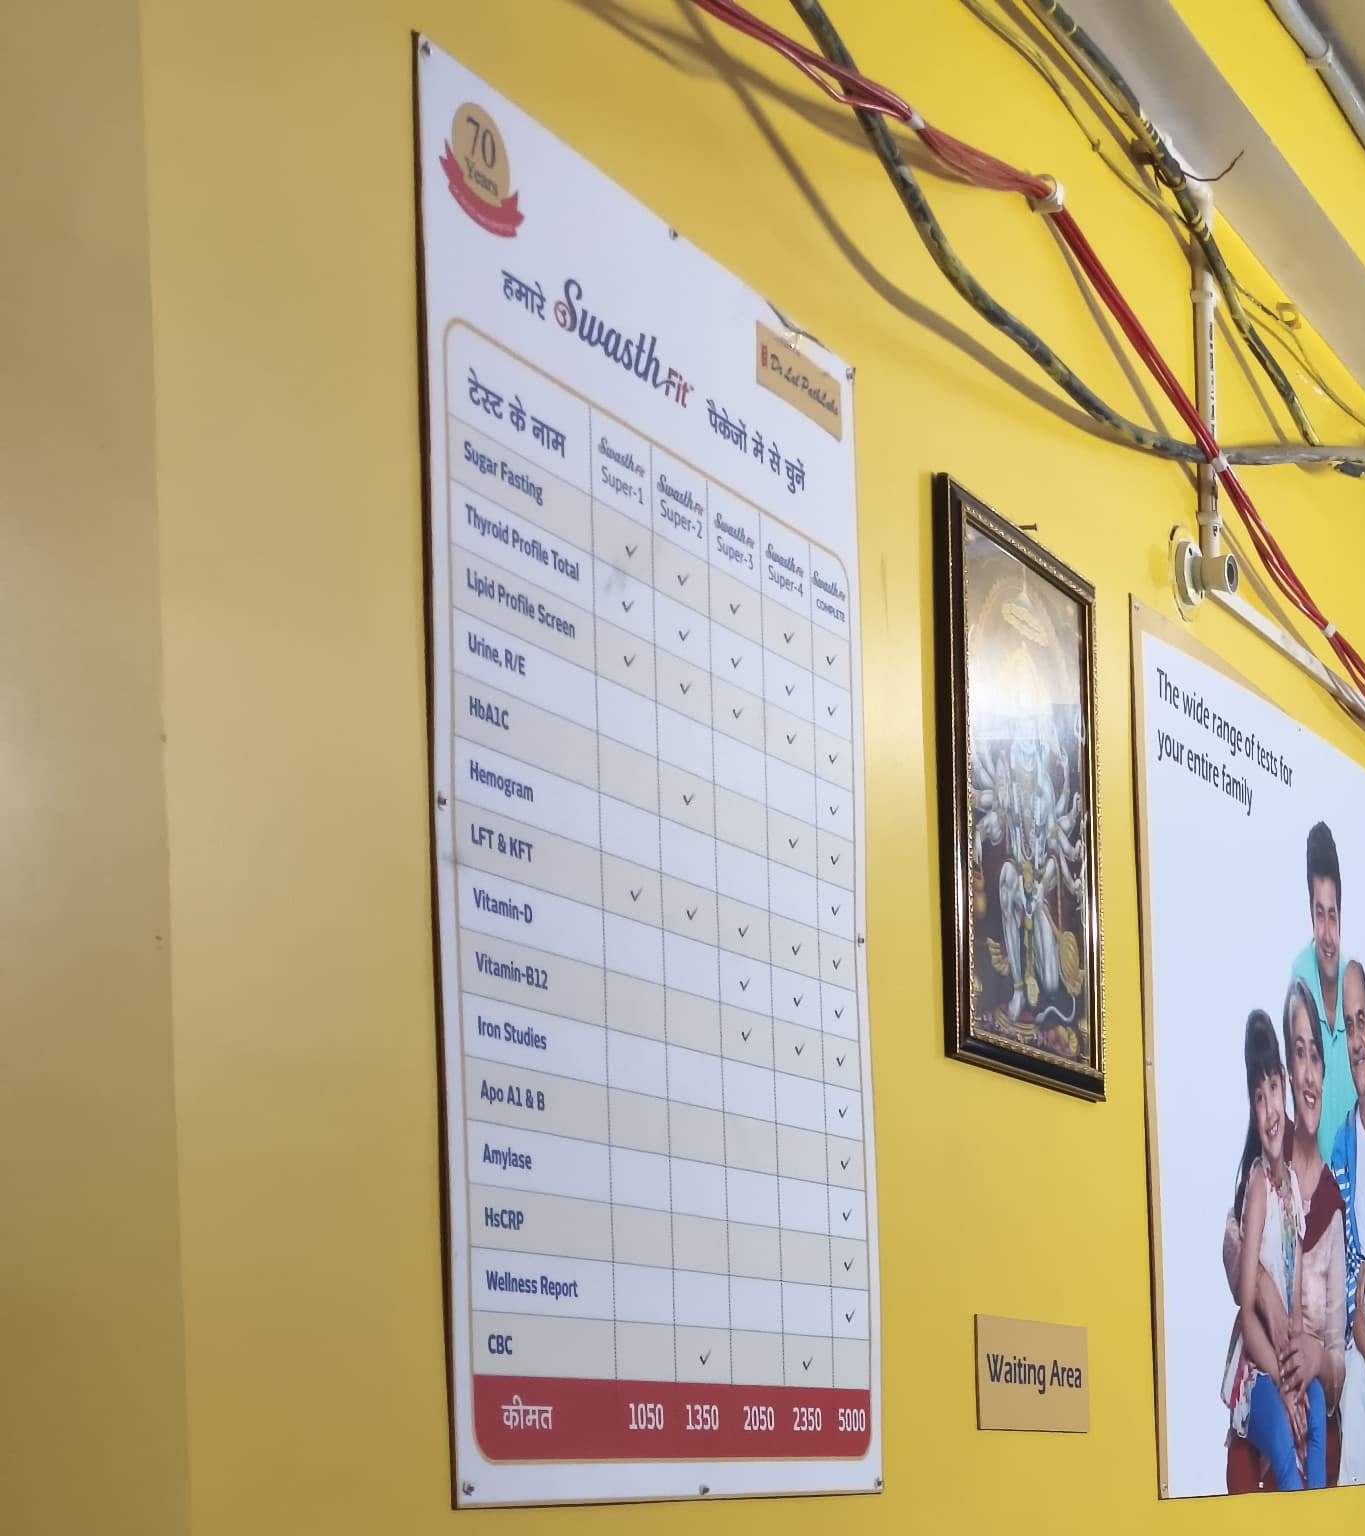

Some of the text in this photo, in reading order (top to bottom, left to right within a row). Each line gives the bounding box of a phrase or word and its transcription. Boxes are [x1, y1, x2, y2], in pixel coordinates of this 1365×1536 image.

[466, 116, 496, 169] 70
[464, 155, 498, 196] Years
[501, 269, 546, 320] हमारे
[752, 430, 764, 464] में
[768, 441, 781, 476] से
[467, 366, 566, 459] टेस्ट के नाम
[463, 441, 544, 507] Sugar Fasting
[601, 465, 644, 505] Super-1
[660, 499, 703, 540] Super-2
[465, 504, 580, 582] Thyroid Profile Total
[716, 535, 754, 571] Super-3
[768, 564, 804, 597] Super-4
[466, 567, 576, 639] Lipid Profile Screen
[815, 598, 845, 622] COMPLETE
[468, 631, 526, 676] Urine, R/E
[469, 696, 509, 731] HbA1C
[1156, 667, 1292, 788] The wide range of tests for
[470, 759, 534, 802] Hemogram
[1157, 728, 1252, 816] your entire family
[471, 823, 534, 863] LFT & KFT
[473, 887, 534, 924] Vitamin-D
[475, 951, 548, 991] Vitamin-B12
[477, 1015, 547, 1050] Iron Studies
[480, 1080, 545, 1111] Apo A1 & B
[483, 1143, 532, 1170] Amylase
[484, 1206, 524, 1231] HsCRP
[486, 1269, 579, 1300] Wellness Report
[487, 1334, 513, 1355] CBC
[986, 1353, 1082, 1394] Waiting Area
[501, 1395, 553, 1431] कीमत
[628, 1403, 866, 1432] 1050 1350 2050 2350 5000
